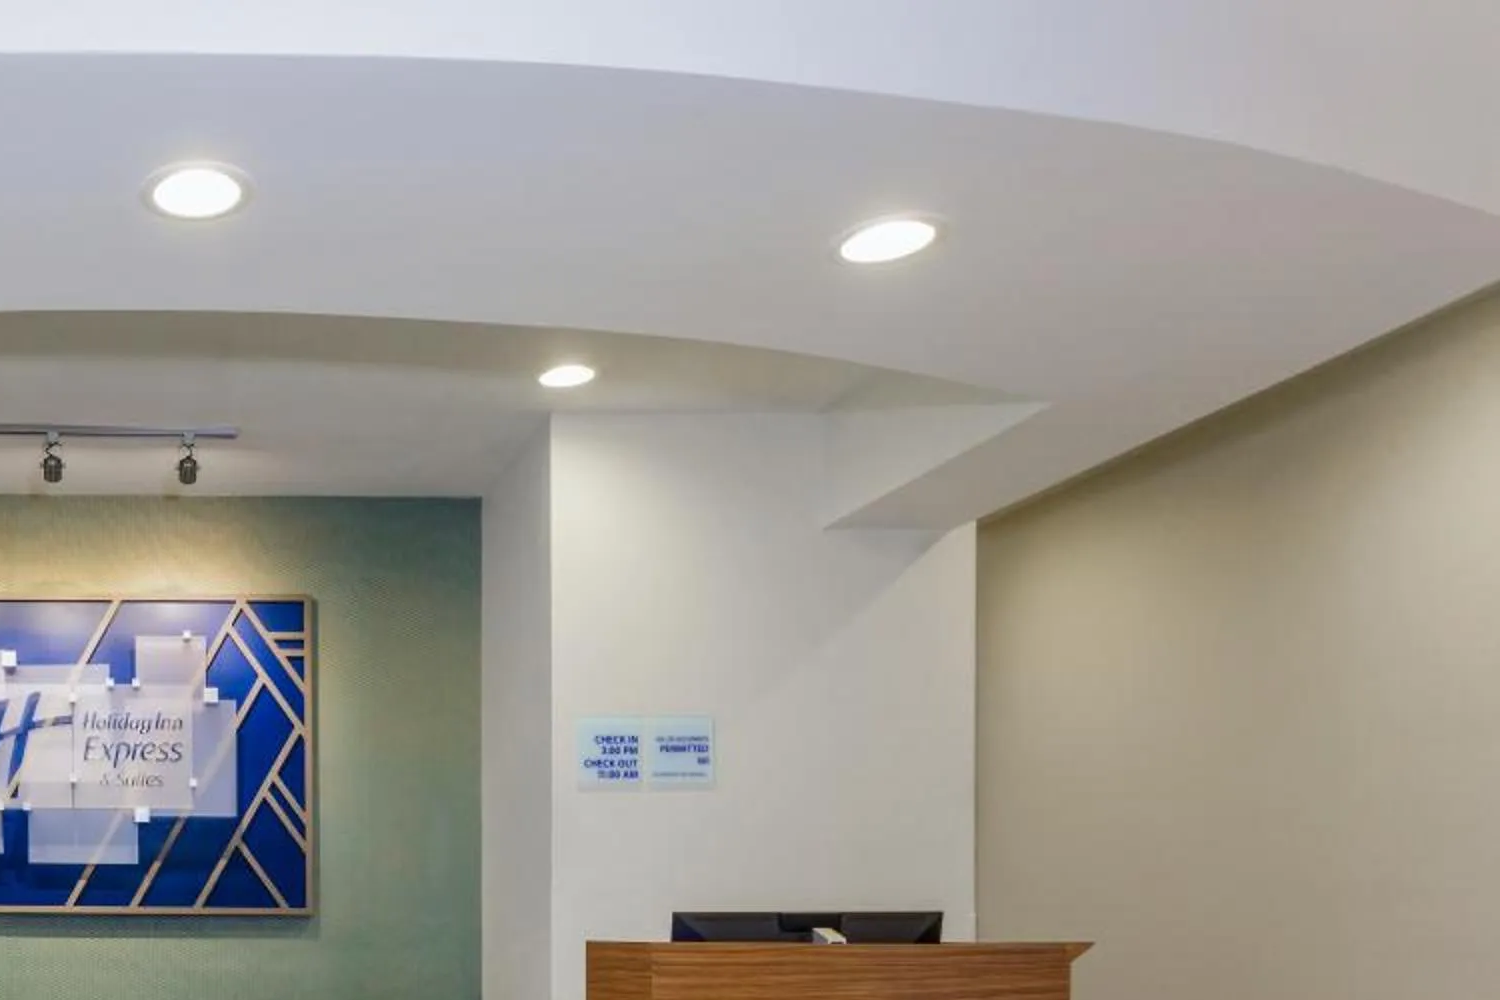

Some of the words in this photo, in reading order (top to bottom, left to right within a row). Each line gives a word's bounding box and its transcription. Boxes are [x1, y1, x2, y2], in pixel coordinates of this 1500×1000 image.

[83, 711, 152, 735] Holiday
[155, 711, 183, 731] Inn
[594, 735, 626, 745] CHECK
[628, 735, 639, 745] IN
[84, 736, 183, 769] Express
[623, 746, 639, 755] PM
[584, 759, 615, 768] CHECK
[617, 759, 638, 768] OUT
